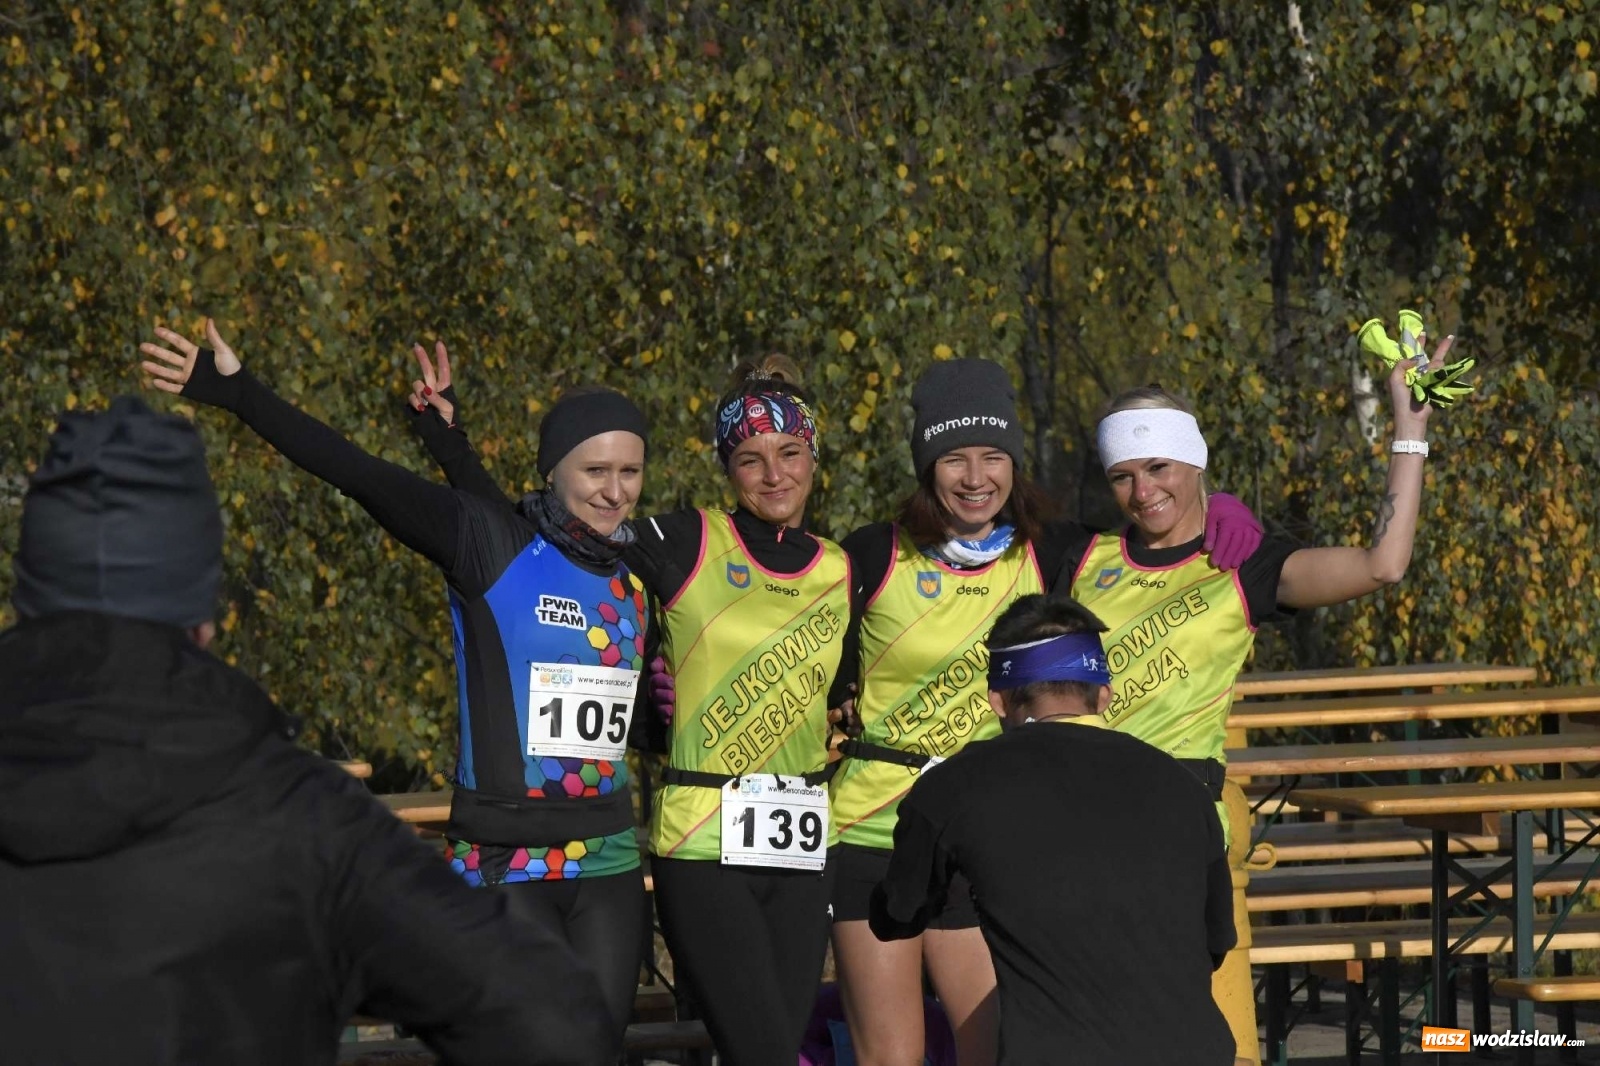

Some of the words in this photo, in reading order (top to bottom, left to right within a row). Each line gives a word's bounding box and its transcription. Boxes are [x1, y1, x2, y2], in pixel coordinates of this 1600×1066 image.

[924, 416, 1008, 441] #tomorrow
[765, 583, 799, 597] deep
[956, 585, 990, 596] deep
[1131, 577, 1166, 589] deep
[542, 597, 578, 613] PWR
[538, 609, 584, 627] TEAM
[1106, 588, 1209, 680] OWICE
[700, 603, 840, 748] JEJKOWICE
[539, 697, 628, 744] 105
[767, 785, 824, 797] wwpersonalbest.pl
[732, 807, 822, 852] 139
